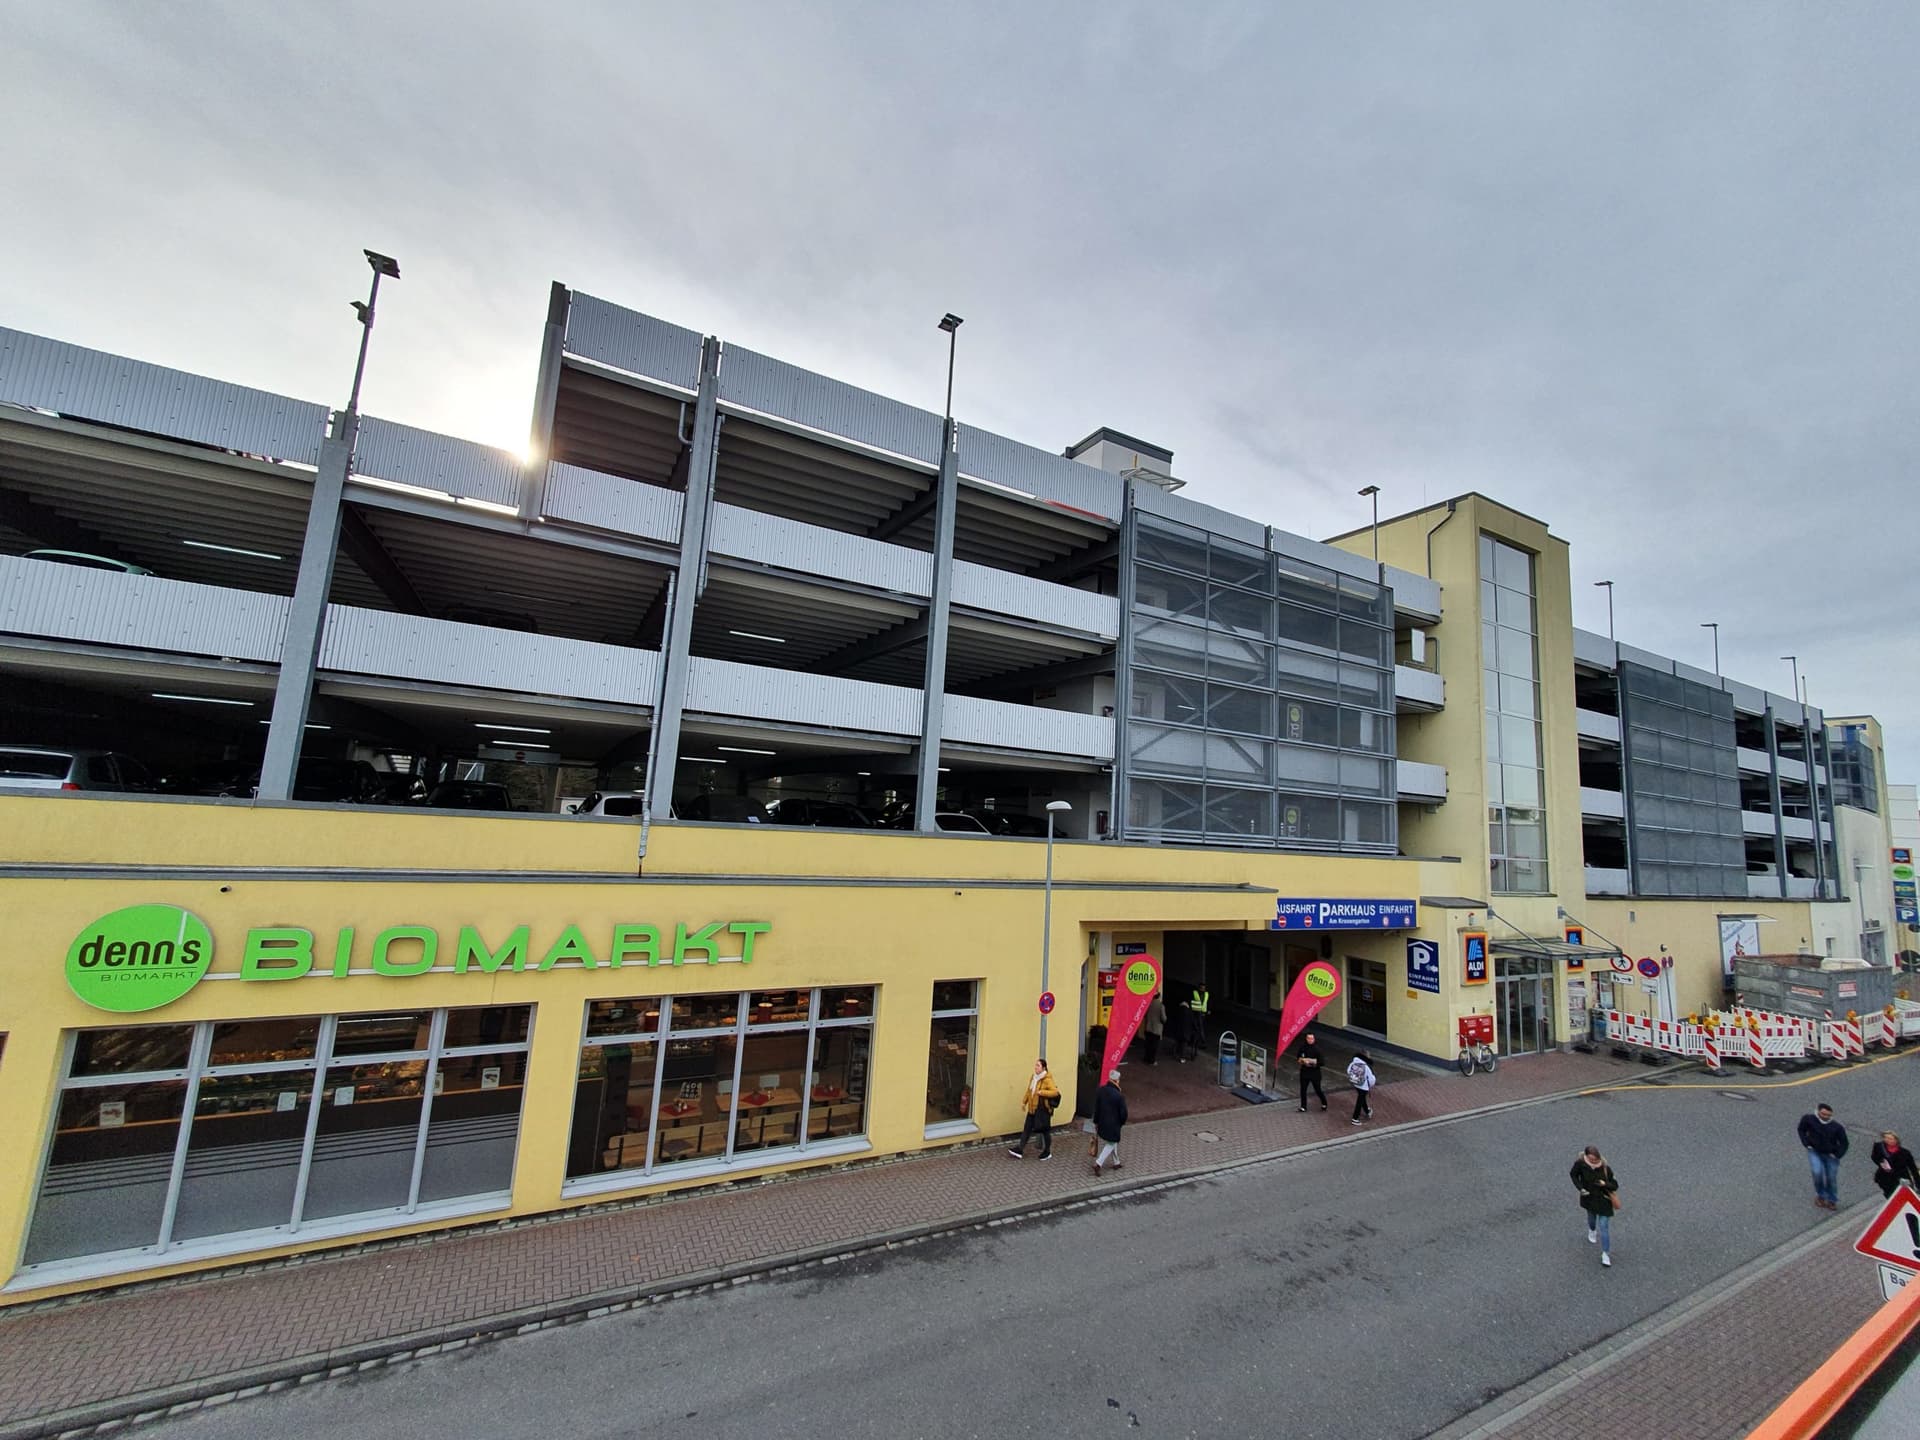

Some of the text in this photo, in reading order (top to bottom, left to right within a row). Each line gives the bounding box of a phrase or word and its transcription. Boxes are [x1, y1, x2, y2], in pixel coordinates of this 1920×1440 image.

[1320, 902, 1376, 925] PARKHAUS
[1379, 904, 1414, 914] EINFAHRT
[239, 922, 773, 982] BIOMARKT
[1413, 946, 1431, 970] P
[1468, 961, 1485, 972] ALDI
[101, 971, 197, 982] BIOMARKT
[1408, 972, 1438, 983] EINFAHRT
[1408, 980, 1439, 990] PARKHAUS
[1890, 1272, 1909, 1287] Ba
